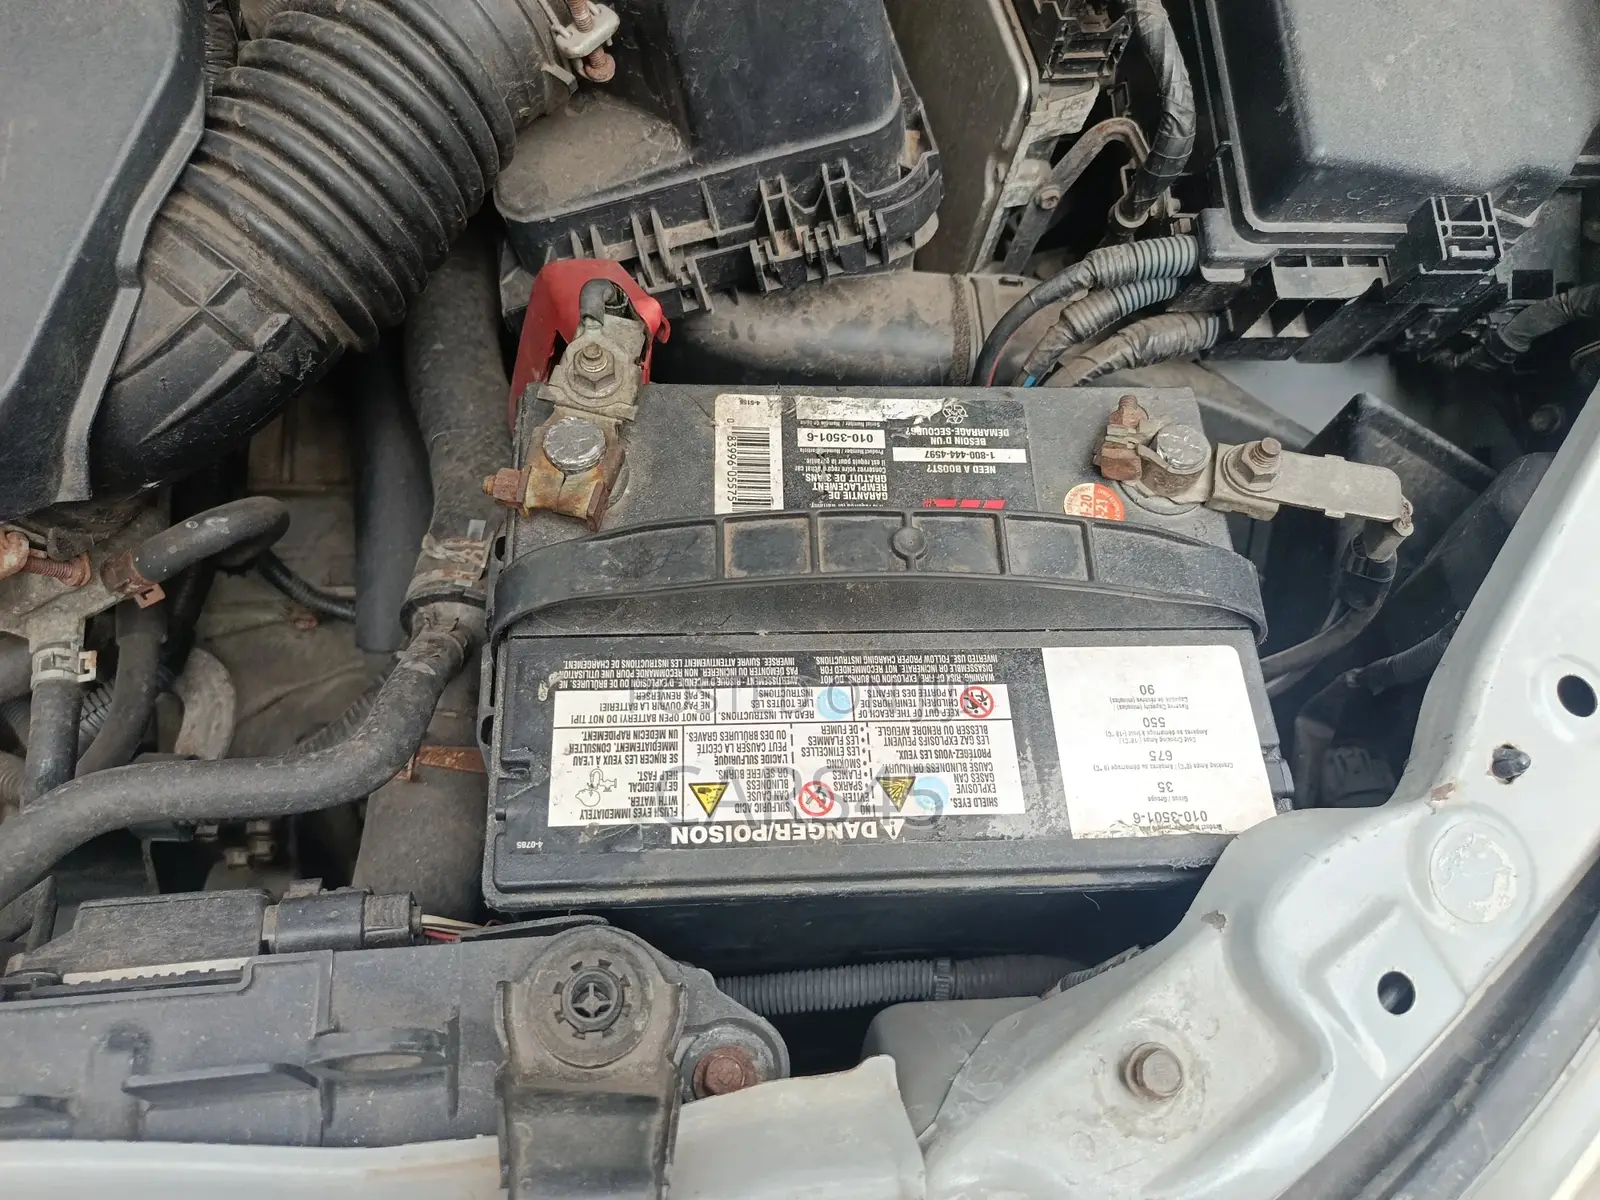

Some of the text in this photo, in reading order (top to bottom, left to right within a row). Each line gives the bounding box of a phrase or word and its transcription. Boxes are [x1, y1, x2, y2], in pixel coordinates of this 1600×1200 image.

[807, 433, 873, 442] 010-3501-6
[906, 428, 1009, 438] DÉMARRAGE-SECOURS?
[955, 437, 986, 445] BESOIN
[727, 436, 737, 466] 83996
[925, 450, 995, 459] 1-800-444-4597
[927, 465, 962, 473] BOOST?
[964, 465, 971, 473] A
[802, 473, 822, 481] ANS.
[849, 474, 887, 482] GRATUIT
[727, 470, 737, 502] 05575
[864, 656, 896, 664] CHARGING
[898, 655, 923, 663] PROPER
[924, 655, 950, 663] FOLLOW
[968, 654, 997, 663] INVERTED
[820, 666, 833, 674] FOR
[835, 665, 884, 673] RECOMMENDED
[886, 665, 898, 673] NOT
[950, 664, 993, 672] DISASSEMBLE
[820, 674, 962, 683] RISK NOT
[684, 691, 698, 699] PAS
[700, 691, 710, 699] NE
[864, 689, 900, 697] ENFANTS.
[902, 689, 916, 697] DES
[948, 688, 957, 696] LA
[1139, 685, 1154, 695] 90
[641, 702, 650, 710] LA
[652, 702, 681, 710] OUVRIR
[684, 702, 699, 710] PAS
[767, 700, 796, 708] TOUTES
[798, 699, 814, 707] LIRE
[860, 700, 871, 708] DE
[873, 699, 893, 708] HORS
[896, 699, 917, 707] TENIR
[607, 714, 618, 723] DO
[660, 714, 680, 722] OPEN
[682, 713, 698, 721] NOT
[700, 713, 711, 721] DO
[779, 711, 793, 719] ALL
[795, 710, 815, 719] READ
[857, 709, 960, 718] KEEP OUT OF THE REACH OF
[588, 715, 605, 723] NOT
[1142, 717, 1165, 727] 550
[669, 729, 678, 739] UN
[821, 724, 858, 735] DE FUMER
[875, 725, 988, 736] BLESSER OU RENDRE AVEUGLE.
[581, 730, 631, 741] RAPIDEMENT.
[686, 730, 787, 744] OU DES BRÛLURES GRAVES.
[883, 735, 989, 746] LES GAZ EXPLOSIFS PEUVENT
[808, 736, 859, 746] LES FLAMMES
[569, 742, 612, 754] CONSULTER
[725, 744, 735, 753] LA
[737, 743, 766, 753] CAUSER
[768, 742, 787, 752] PEUT
[801, 746, 860, 760] LES ÉTINCELLES
[896, 749, 991, 761] PROTÉGEZ-VOUS LES YEUX.
[1149, 750, 1172, 761] 675
[572, 753, 678, 768] SE RINCER LES YEUX À L'EAU
[714, 753, 788, 766] L'ACIDE SULFURIQUE
[826, 758, 861, 769] SMOKING
[882, 762, 993, 774] CAUSE BLINDNESS OR INJURY.
[637, 770, 678, 781] HELP FAST.
[716, 768, 788, 780] OR SEVERE BURNS.
[832, 769, 862, 780] FLAMES
[953, 773, 995, 783] GASES CAN
[628, 782, 678, 792] GET MEDICAL
[746, 780, 788, 790] BLINDNESS
[833, 781, 862, 791] SPARKS
[956, 784, 996, 794] EXPLOSIVE
[1157, 782, 1173, 792] 35
[747, 790, 789, 801] CAN CAUSE
[628, 795, 678, 807] WITH WATER.
[950, 797, 998, 808] SHIELD EYES.
[734, 802, 790, 813] SULFURIC ACID
[860, 805, 871, 815] NO
[579, 806, 678, 820] FLUSH EYES IMMEDIATELY
[1133, 811, 1208, 823] 010-3501-6
[671, 821, 877, 843] DANGER/POISON
